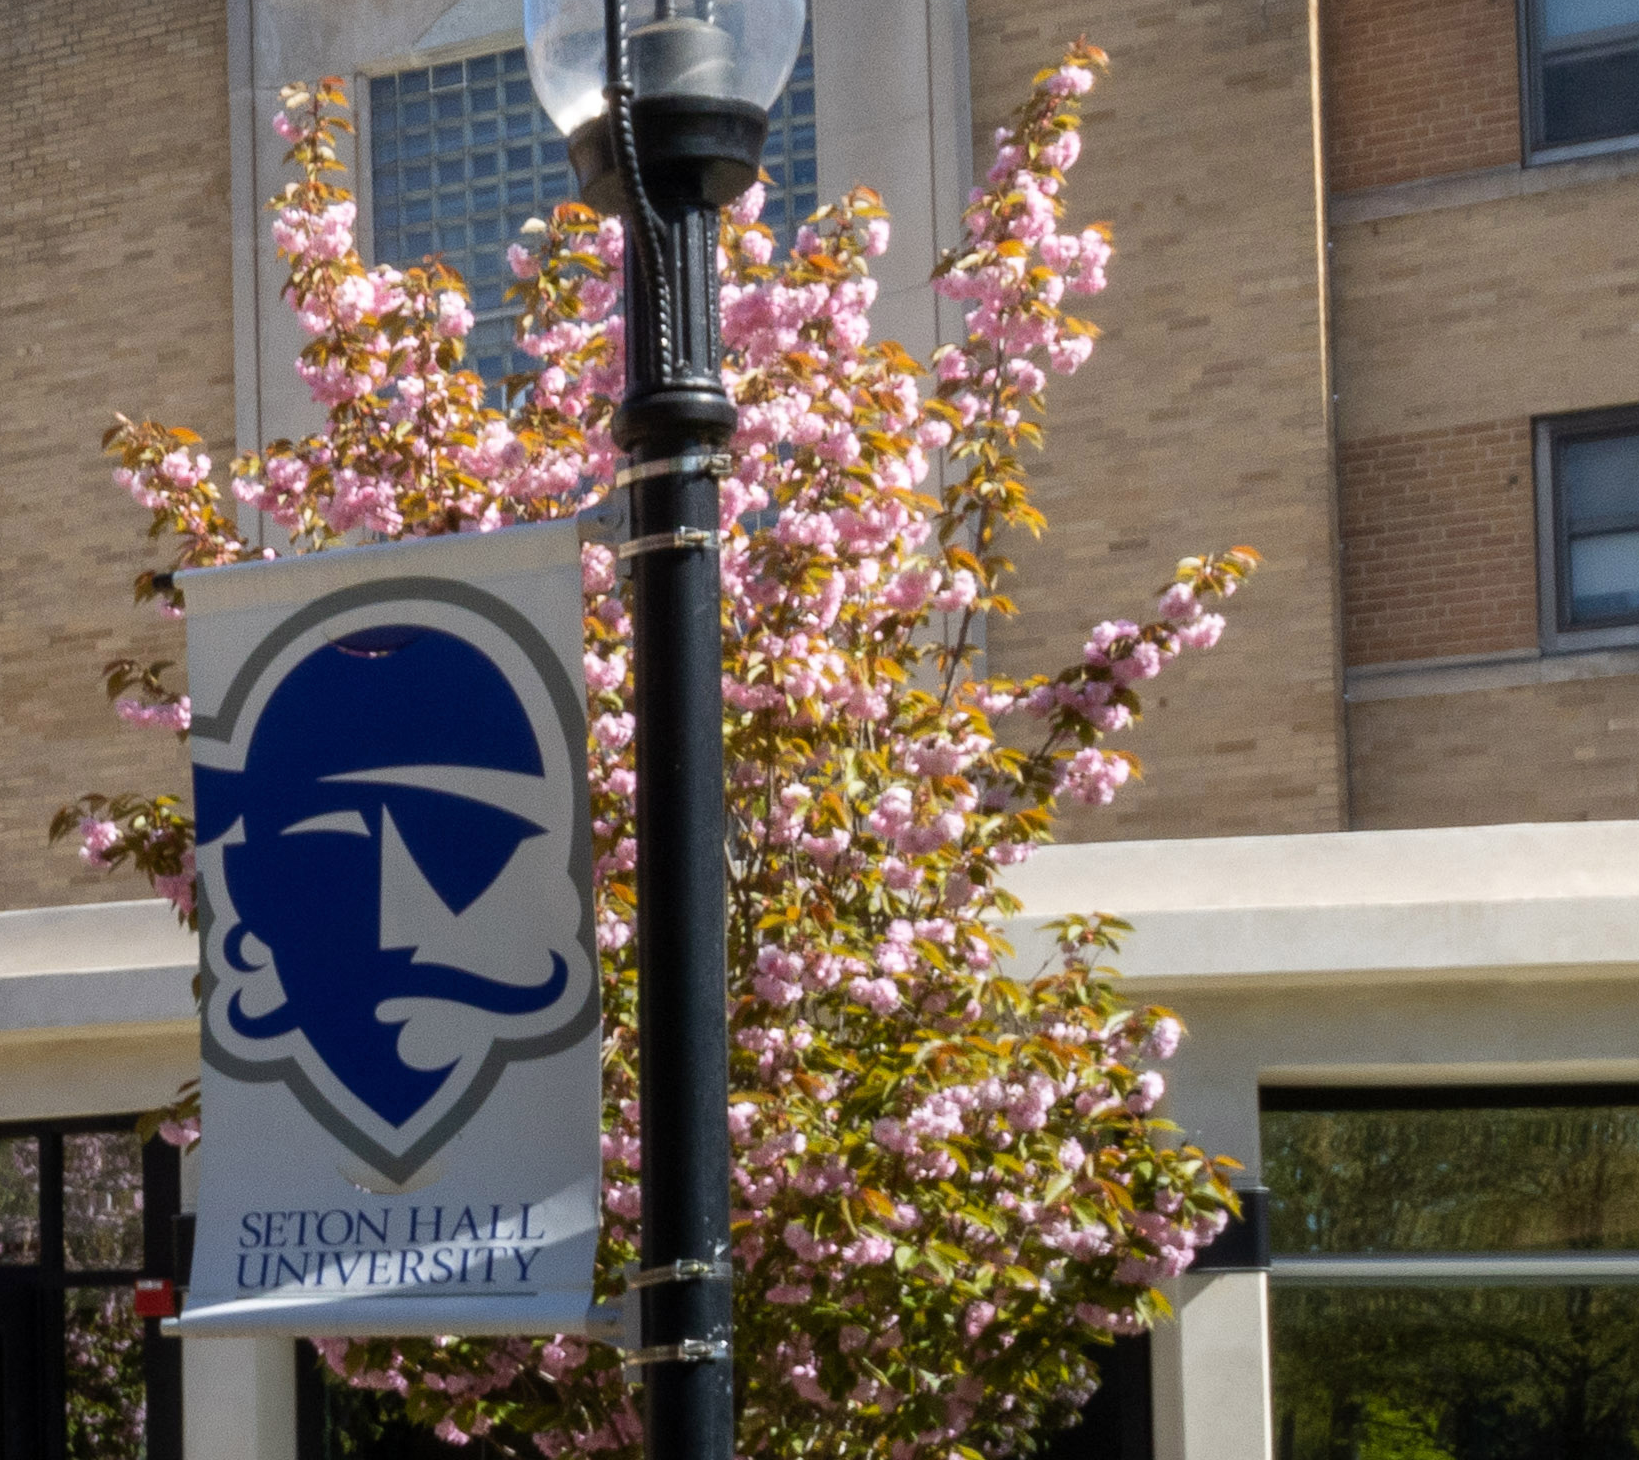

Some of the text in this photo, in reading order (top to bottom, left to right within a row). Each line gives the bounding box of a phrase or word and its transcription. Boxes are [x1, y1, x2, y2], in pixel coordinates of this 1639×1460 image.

[239, 1203, 546, 1248] SETON HALL
[237, 1246, 542, 1288] UNIVERSITY
